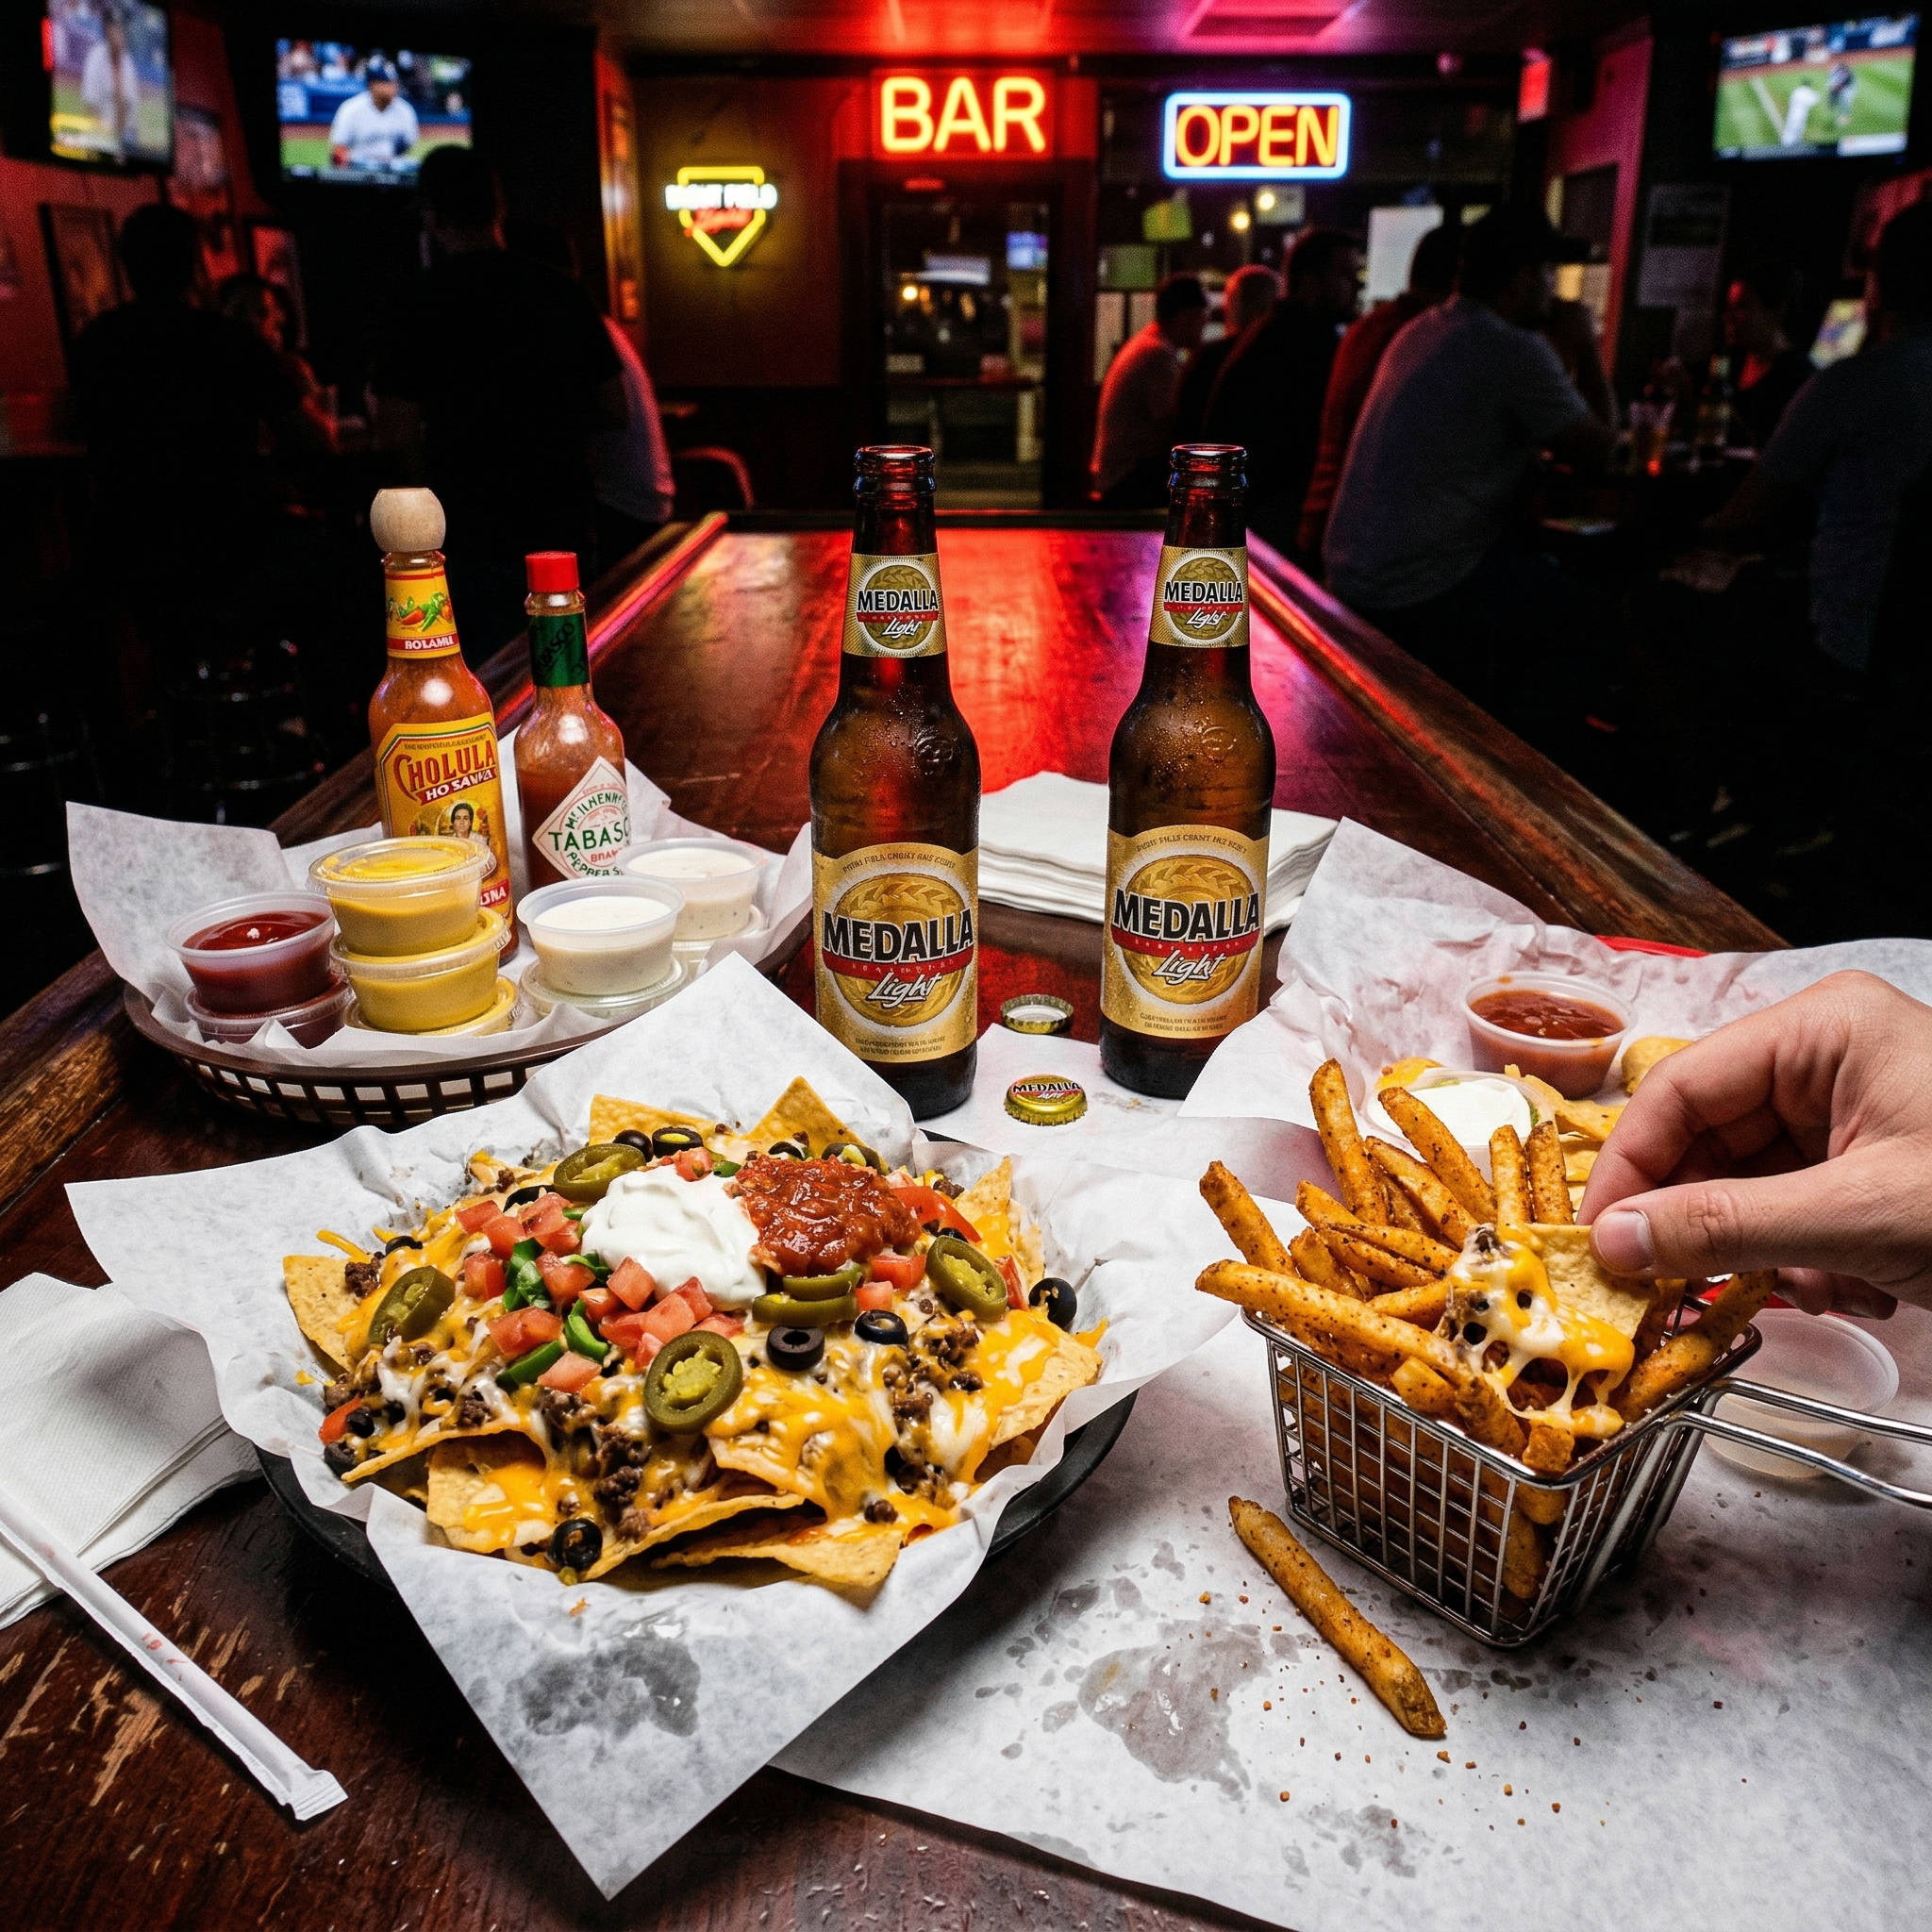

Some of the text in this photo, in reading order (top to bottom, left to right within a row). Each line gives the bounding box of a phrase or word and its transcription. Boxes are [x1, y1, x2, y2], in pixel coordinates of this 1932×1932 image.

[881, 76, 1046, 153] BAR
[1175, 104, 1341, 168] OPEN
[857, 589, 940, 612] MEDALLA
[1164, 580, 1243, 603] MEDALLA
[392, 740, 496, 802] CHOLULA
[822, 907, 974, 963] MEDALLA
[1112, 887, 1260, 942] MEDALLA
[865, 972, 942, 1008] Light
[1152, 949, 1226, 985] Light
